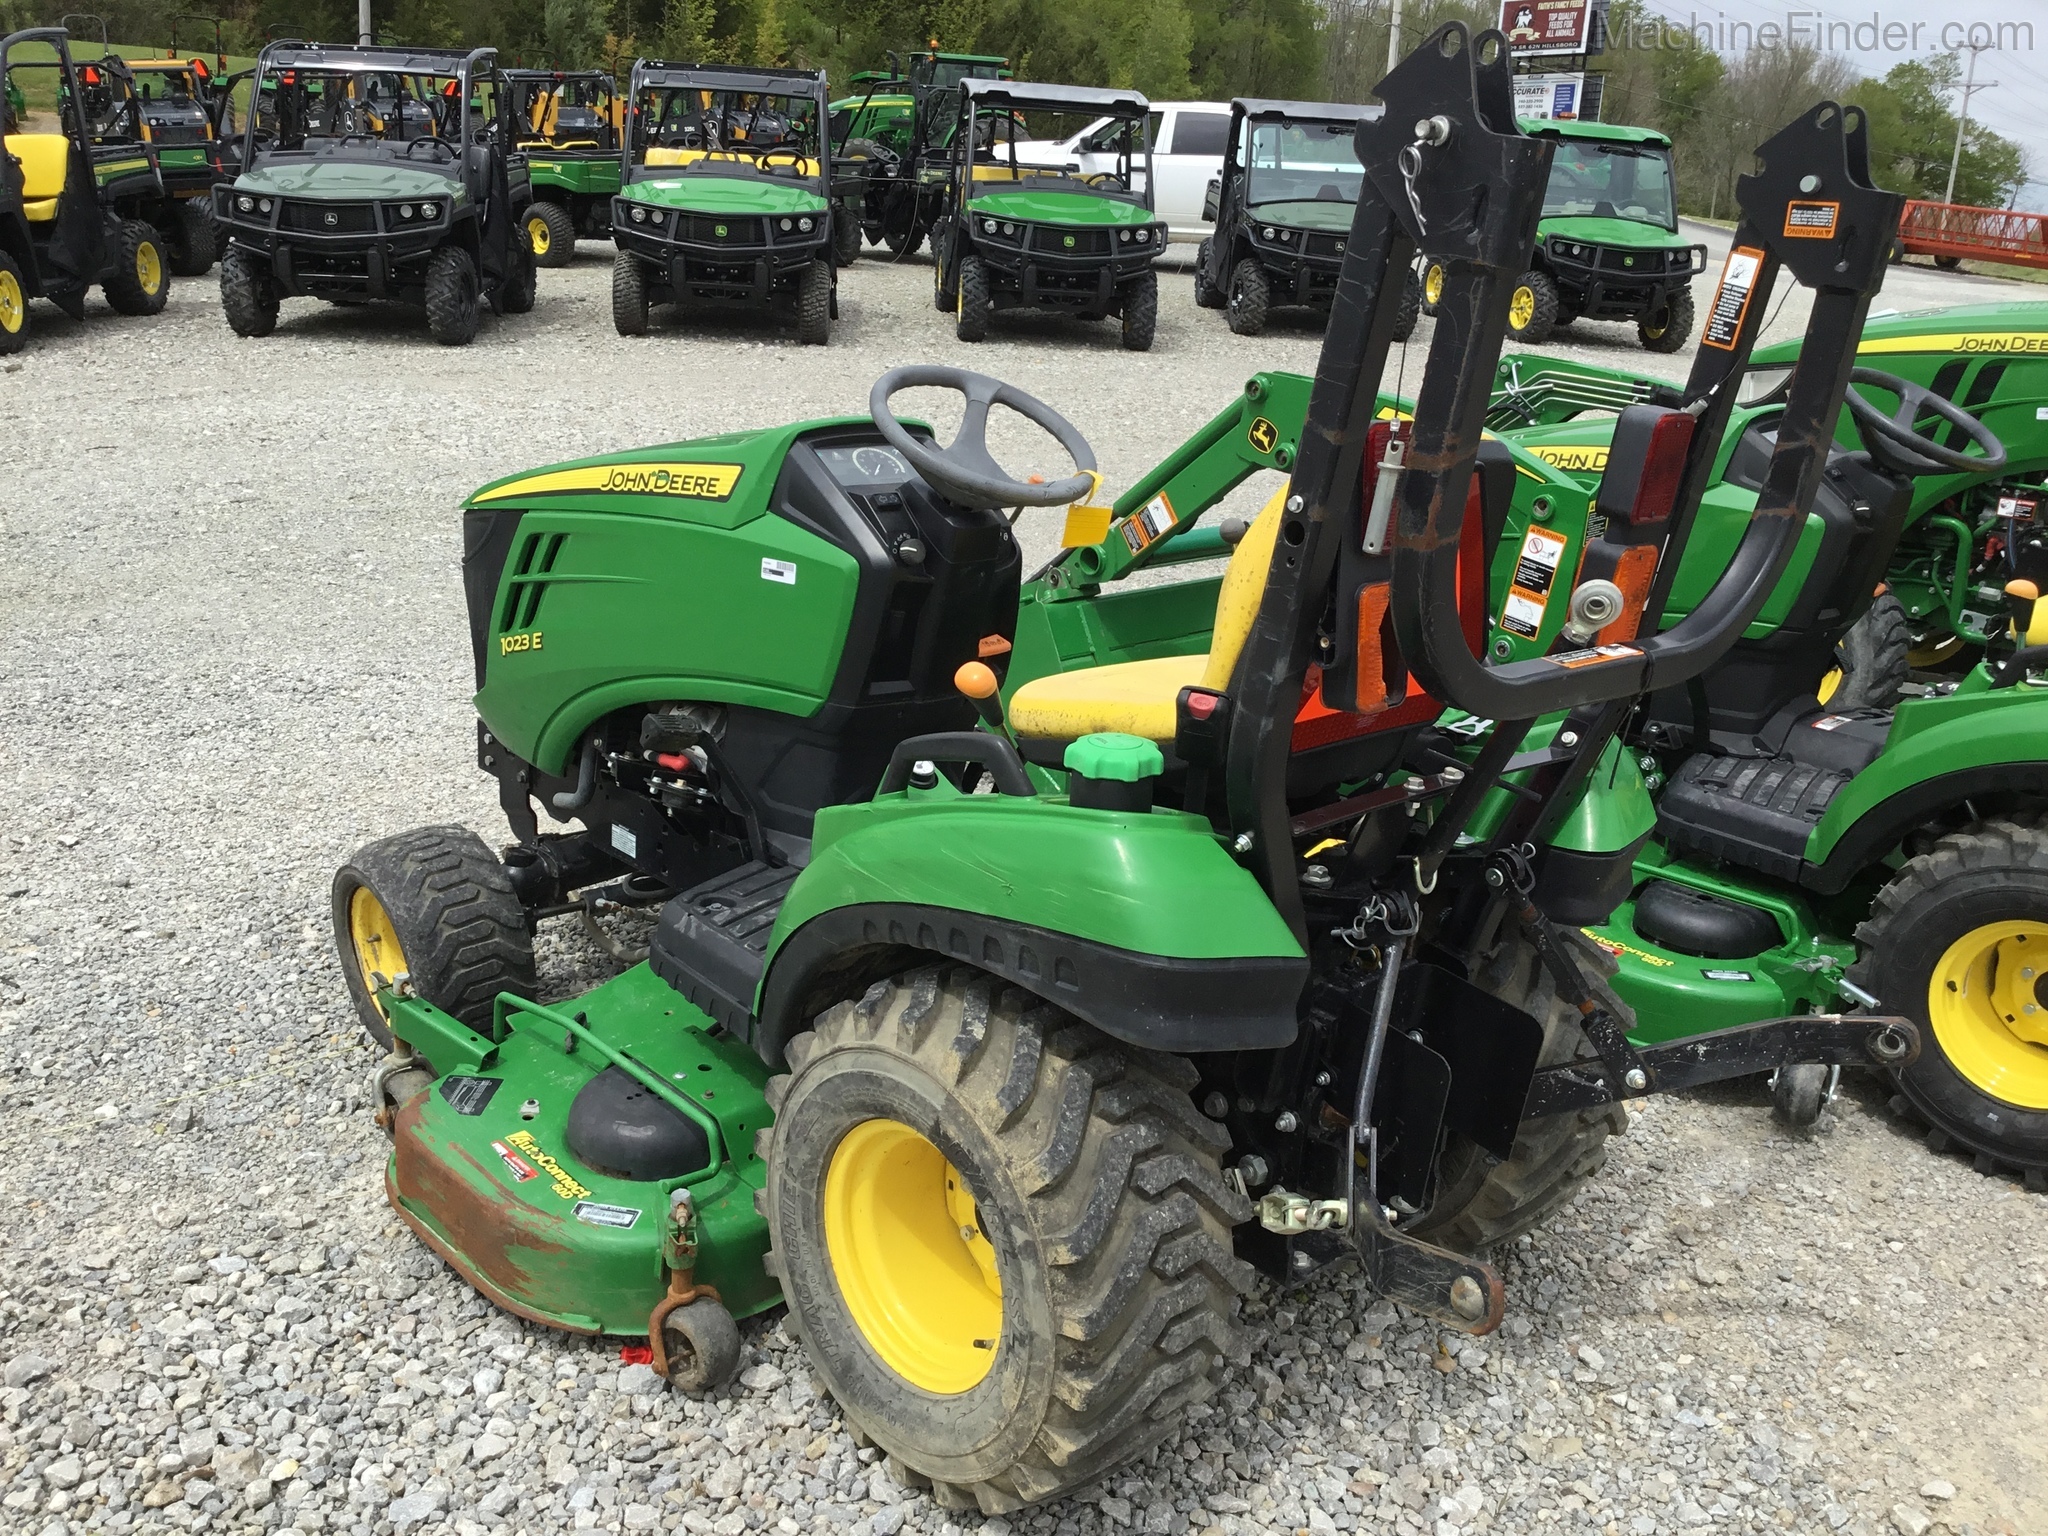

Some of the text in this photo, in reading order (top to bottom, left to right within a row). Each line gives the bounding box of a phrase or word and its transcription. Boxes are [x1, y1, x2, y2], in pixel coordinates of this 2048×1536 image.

[1555, 1, 1569, 9] FANCY
[1569, 0, 1584, 8] FEEDS
[1548, 11, 1578, 21] TOP QUALITY
[1548, 20, 1573, 29] FEEDS FOR
[1555, 28, 1575, 37] ANIMALS
[1513, 87, 1545, 95] CCURATE
[1786, 227, 1824, 237] WARNING
[1953, 336, 2008, 350] JOHN
[601, 468, 720, 494] JOHN DEERE
[1534, 529, 1565, 543] WARNING
[1515, 590, 1545, 605] WARNING
[500, 632, 543, 656] 1023 E
[507, 1134, 592, 1199] AutoConnect
[551, 1183, 574, 1199] 60D
[781, 1156, 801, 1261] CHIEF
